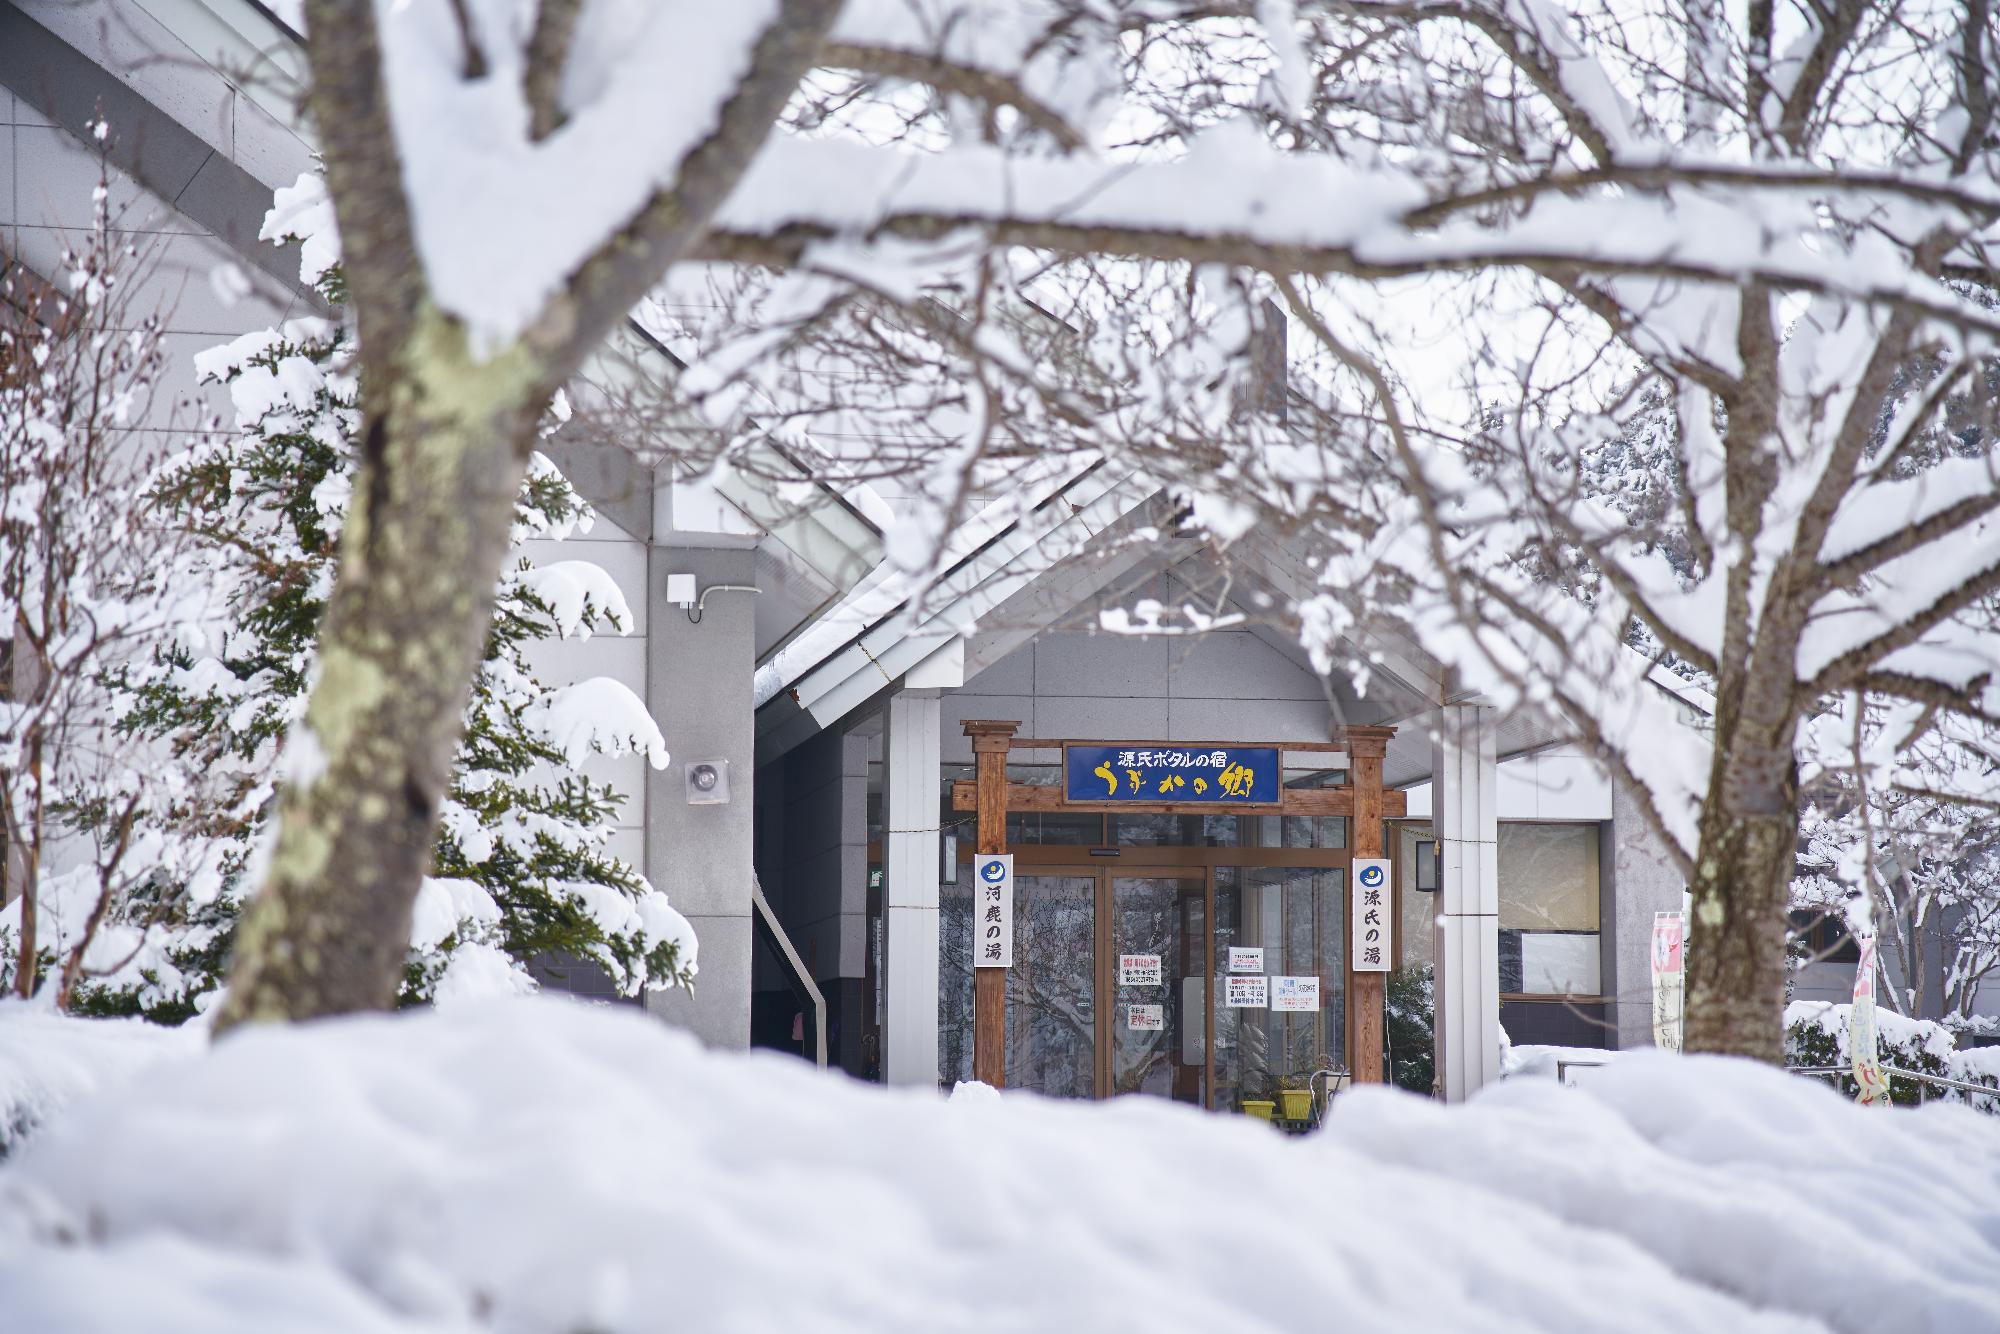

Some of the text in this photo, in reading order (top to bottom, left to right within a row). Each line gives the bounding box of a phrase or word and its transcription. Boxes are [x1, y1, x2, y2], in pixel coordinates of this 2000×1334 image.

[1118, 750, 1227, 768] 源氏ボタルの宿
[985, 886, 1002, 961] 河鹿の湯
[1364, 889, 1382, 965] 源氏の湯
